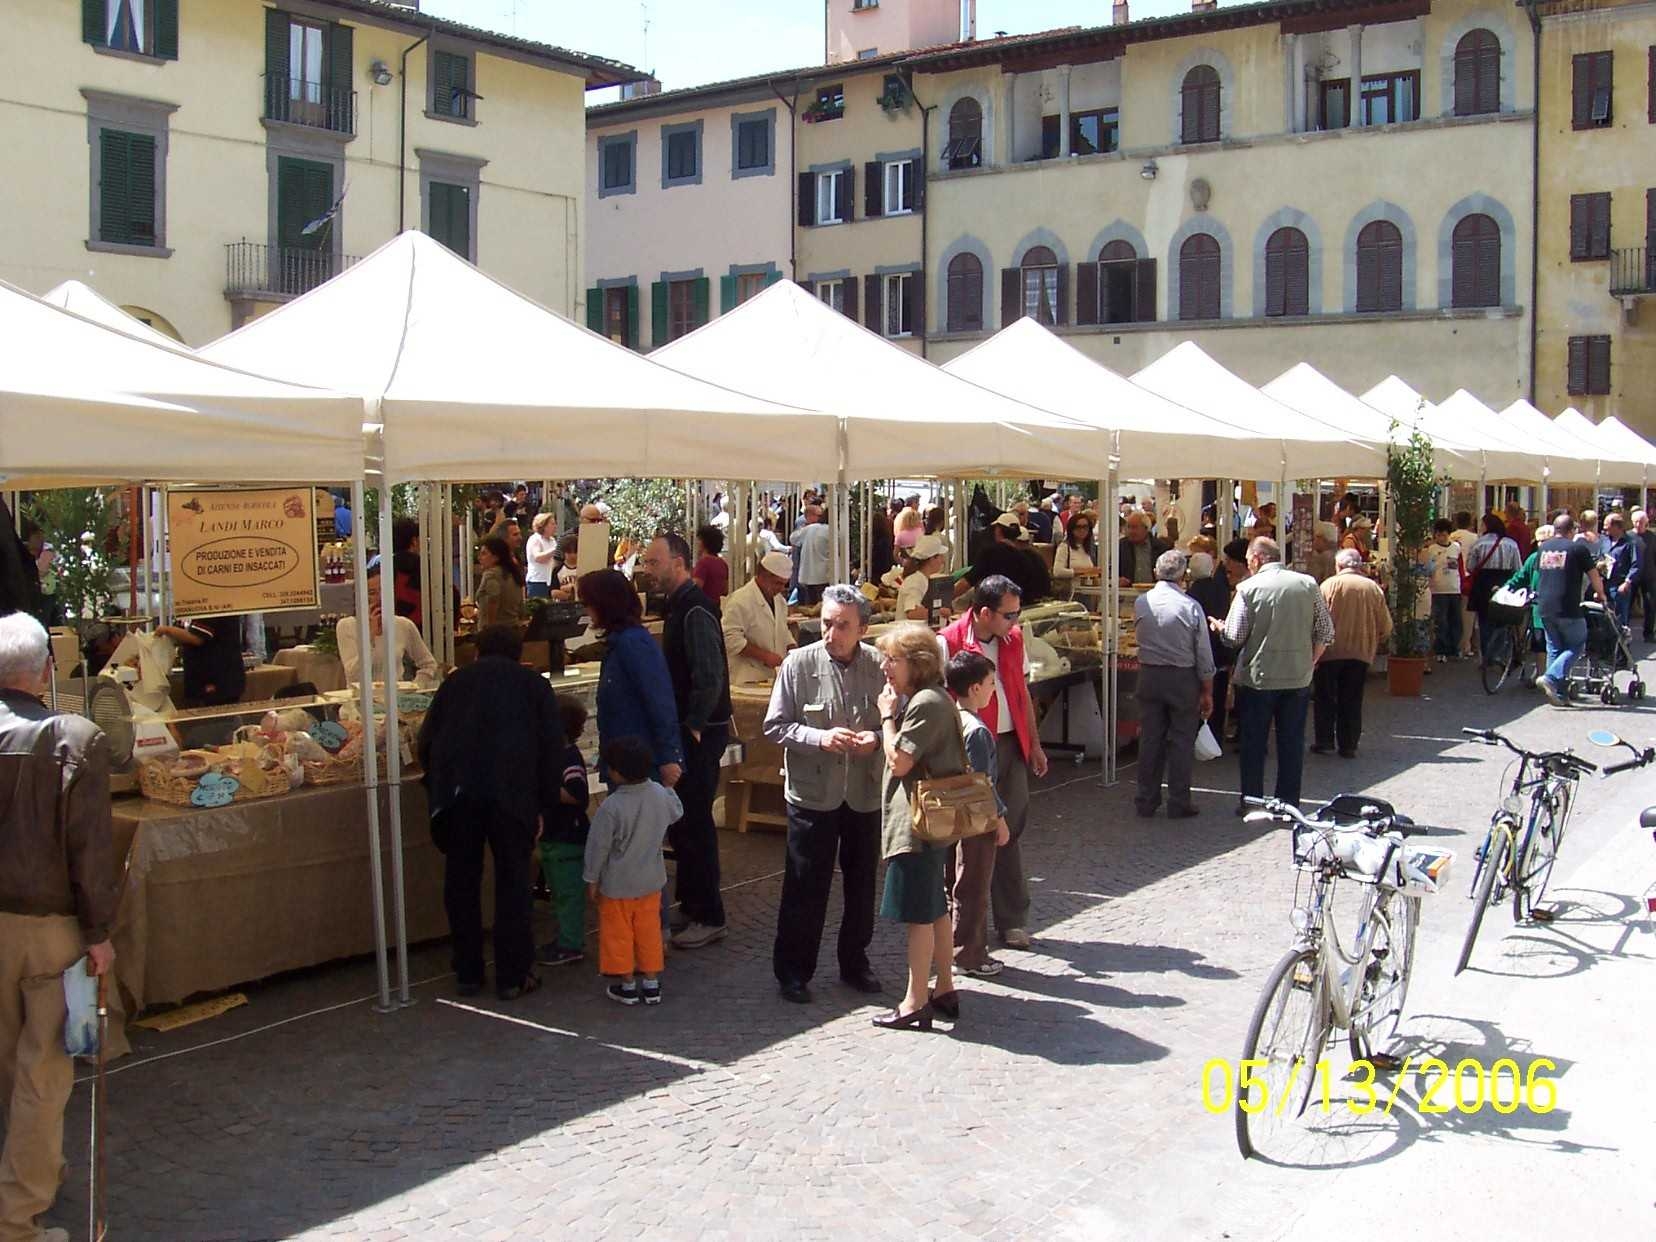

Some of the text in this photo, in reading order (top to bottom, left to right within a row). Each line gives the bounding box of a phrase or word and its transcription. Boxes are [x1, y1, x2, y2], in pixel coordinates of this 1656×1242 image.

[200, 519, 284, 533] LANDI MARCO
[196, 547, 287, 561] PRODUZIONE E VENDITA
[197, 560, 286, 576] DI CARNI ED INSACCATI
